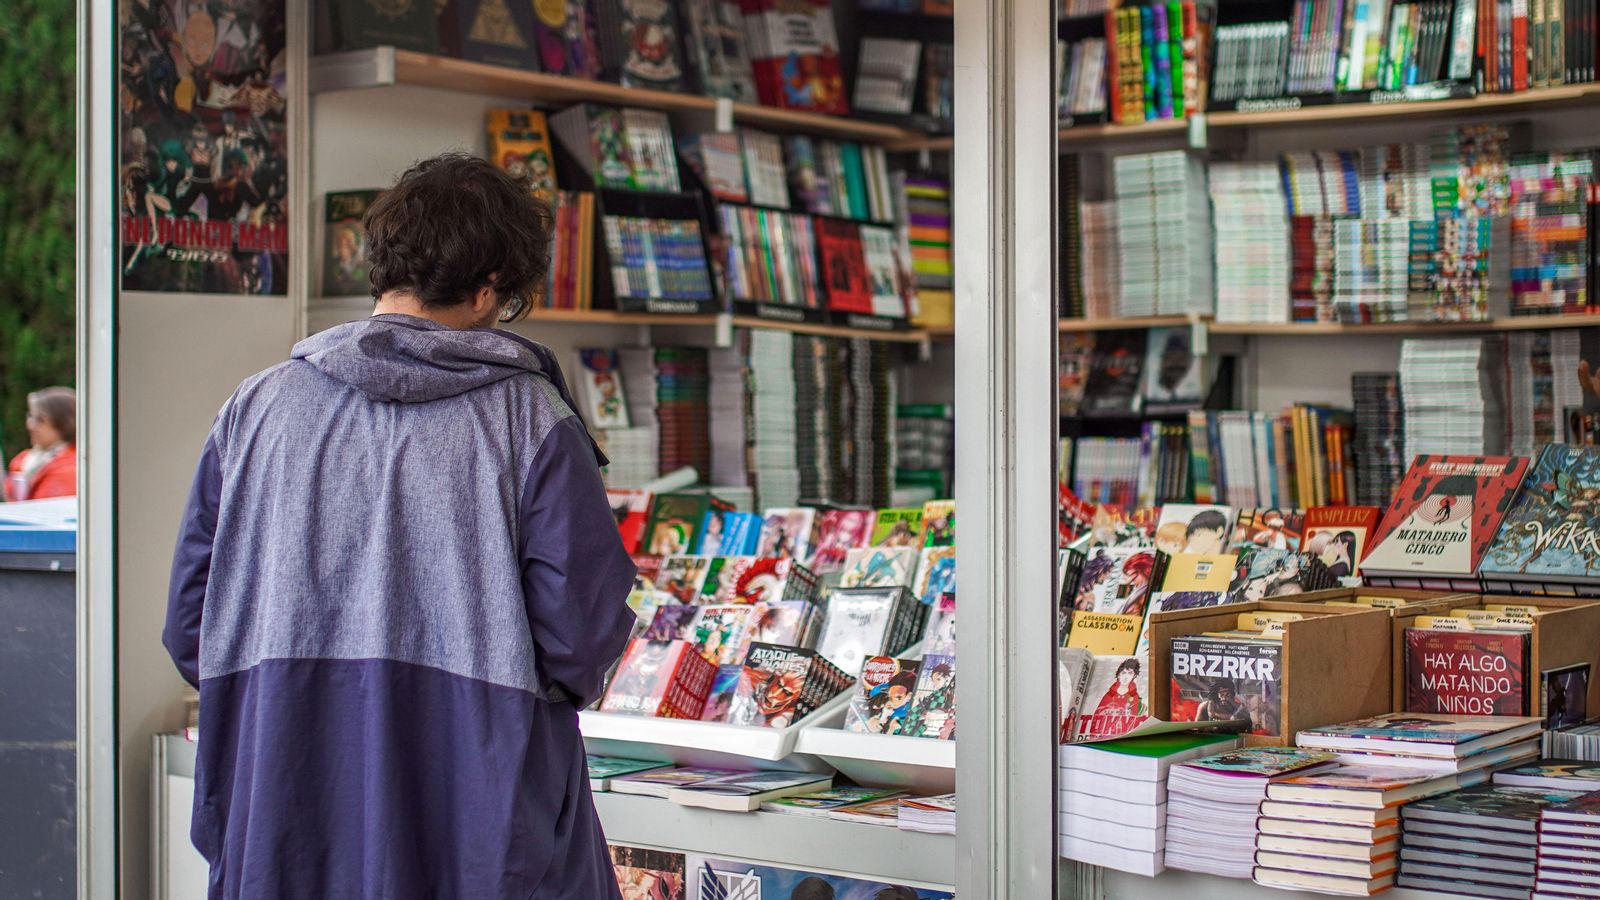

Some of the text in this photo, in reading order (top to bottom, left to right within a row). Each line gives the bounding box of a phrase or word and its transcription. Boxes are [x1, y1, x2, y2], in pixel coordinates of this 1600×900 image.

[238, 223, 287, 252] MAN
[1429, 462, 1455, 472] KURT
[1396, 529, 1467, 543] MATADERO
[1405, 543, 1445, 555] CINCO
[1077, 620, 1134, 633] CLASSROOM
[1083, 615, 1133, 624] ASSASSINATION
[749, 648, 805, 662] ATAQUE
[1424, 652, 1507, 672] HAY ALGO
[1173, 652, 1275, 682] BRZRKR
[1421, 673, 1510, 694] MATANDO
[1437, 694, 1494, 715] NIÑOS
